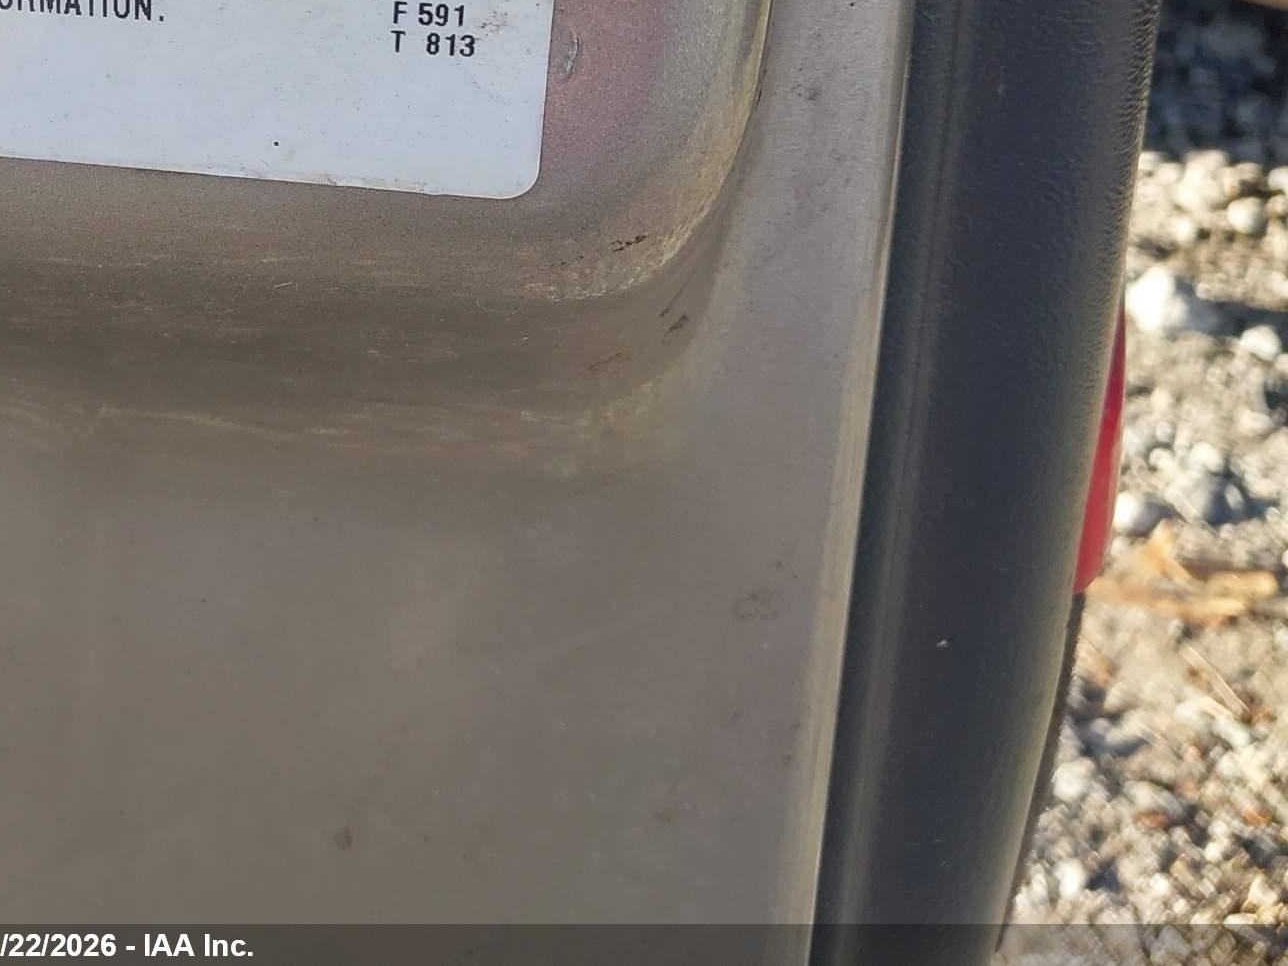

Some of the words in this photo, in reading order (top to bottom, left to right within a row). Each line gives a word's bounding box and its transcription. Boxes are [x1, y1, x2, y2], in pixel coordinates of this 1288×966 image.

[393, 1, 408, 24] F
[418, 2, 464, 27] 591
[390, 30, 406, 52] T
[426, 32, 479, 57] 813
